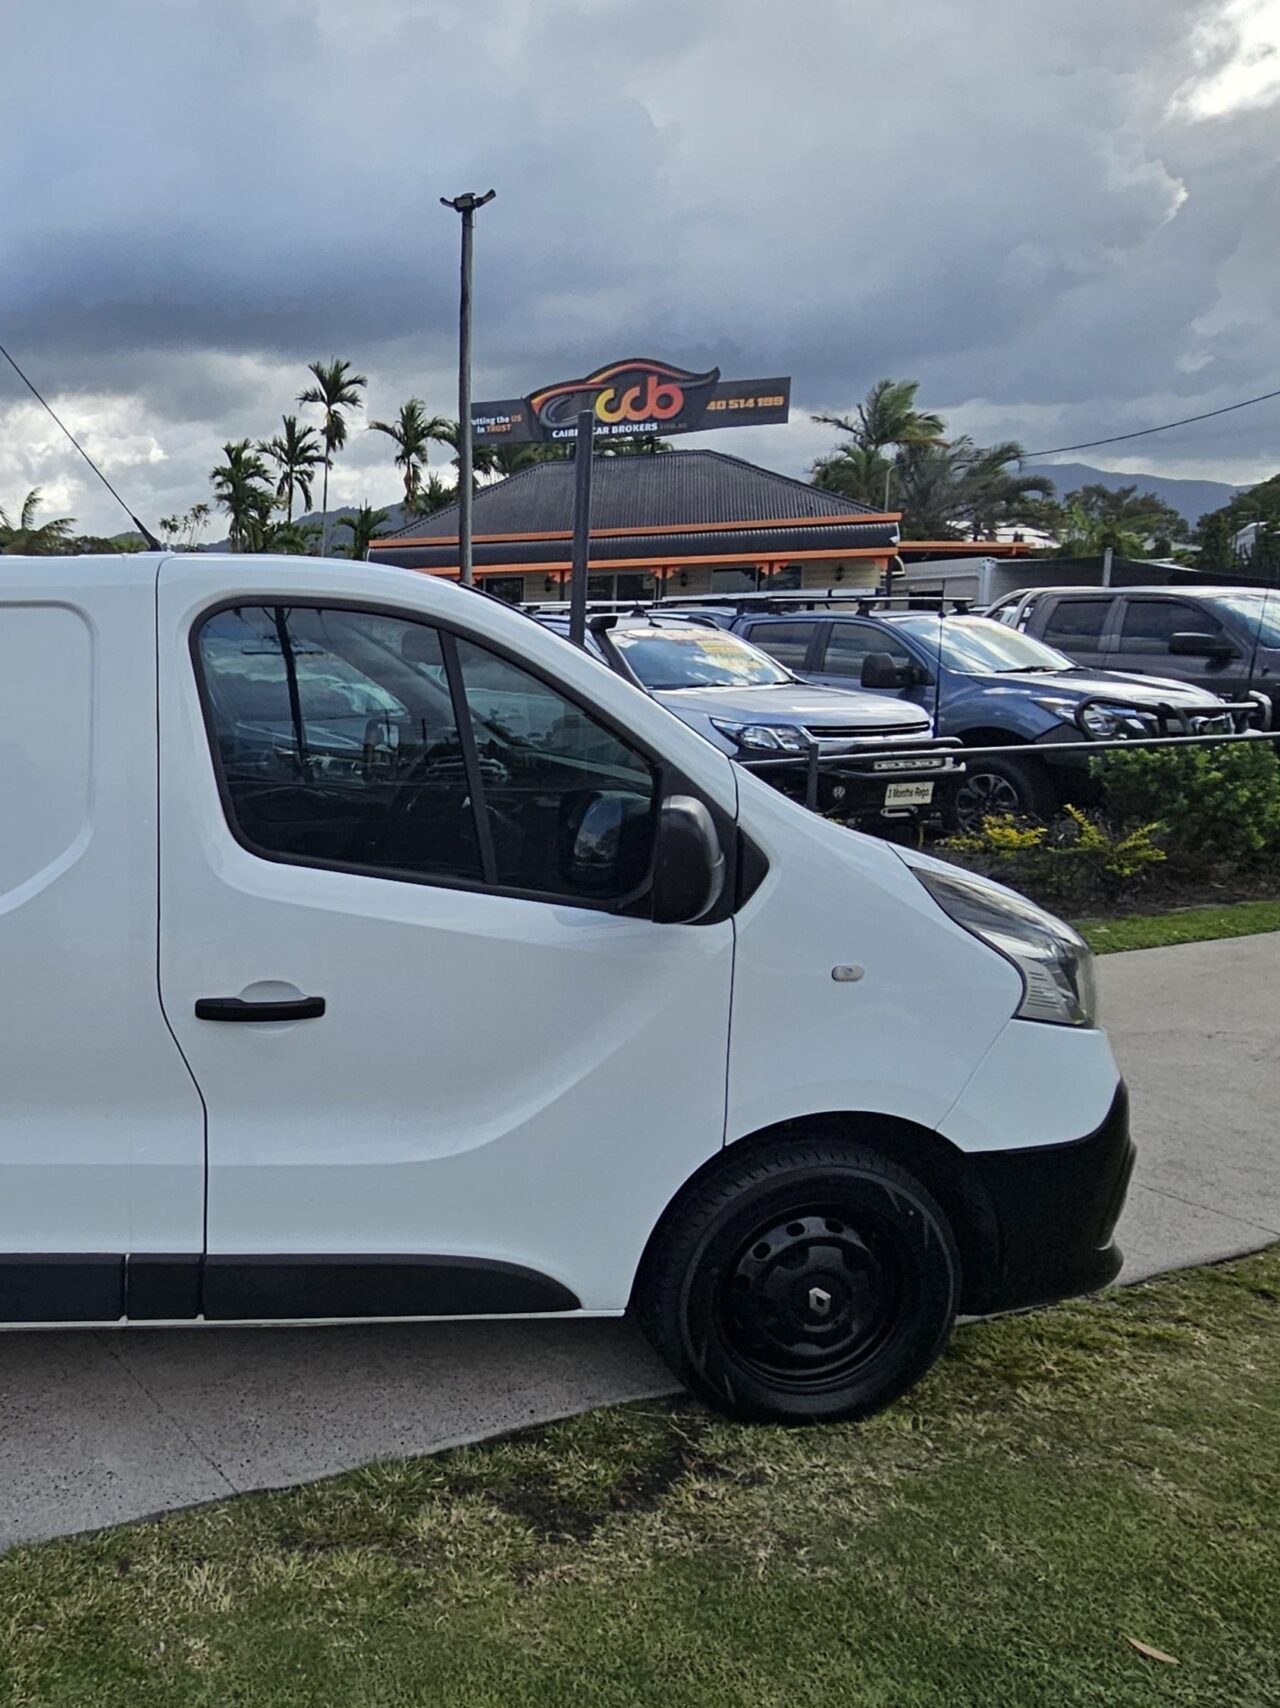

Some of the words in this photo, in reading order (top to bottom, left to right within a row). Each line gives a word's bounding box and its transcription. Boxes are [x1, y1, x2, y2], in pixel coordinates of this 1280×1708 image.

[706, 400, 726, 410] 40
[728, 398, 755, 409] 514
[471, 417, 496, 426] utting
[496, 415, 510, 423] the
[486, 423, 512, 433] TRUST
[552, 428, 578, 438] CAIR
[612, 422, 658, 434] BROKERS
